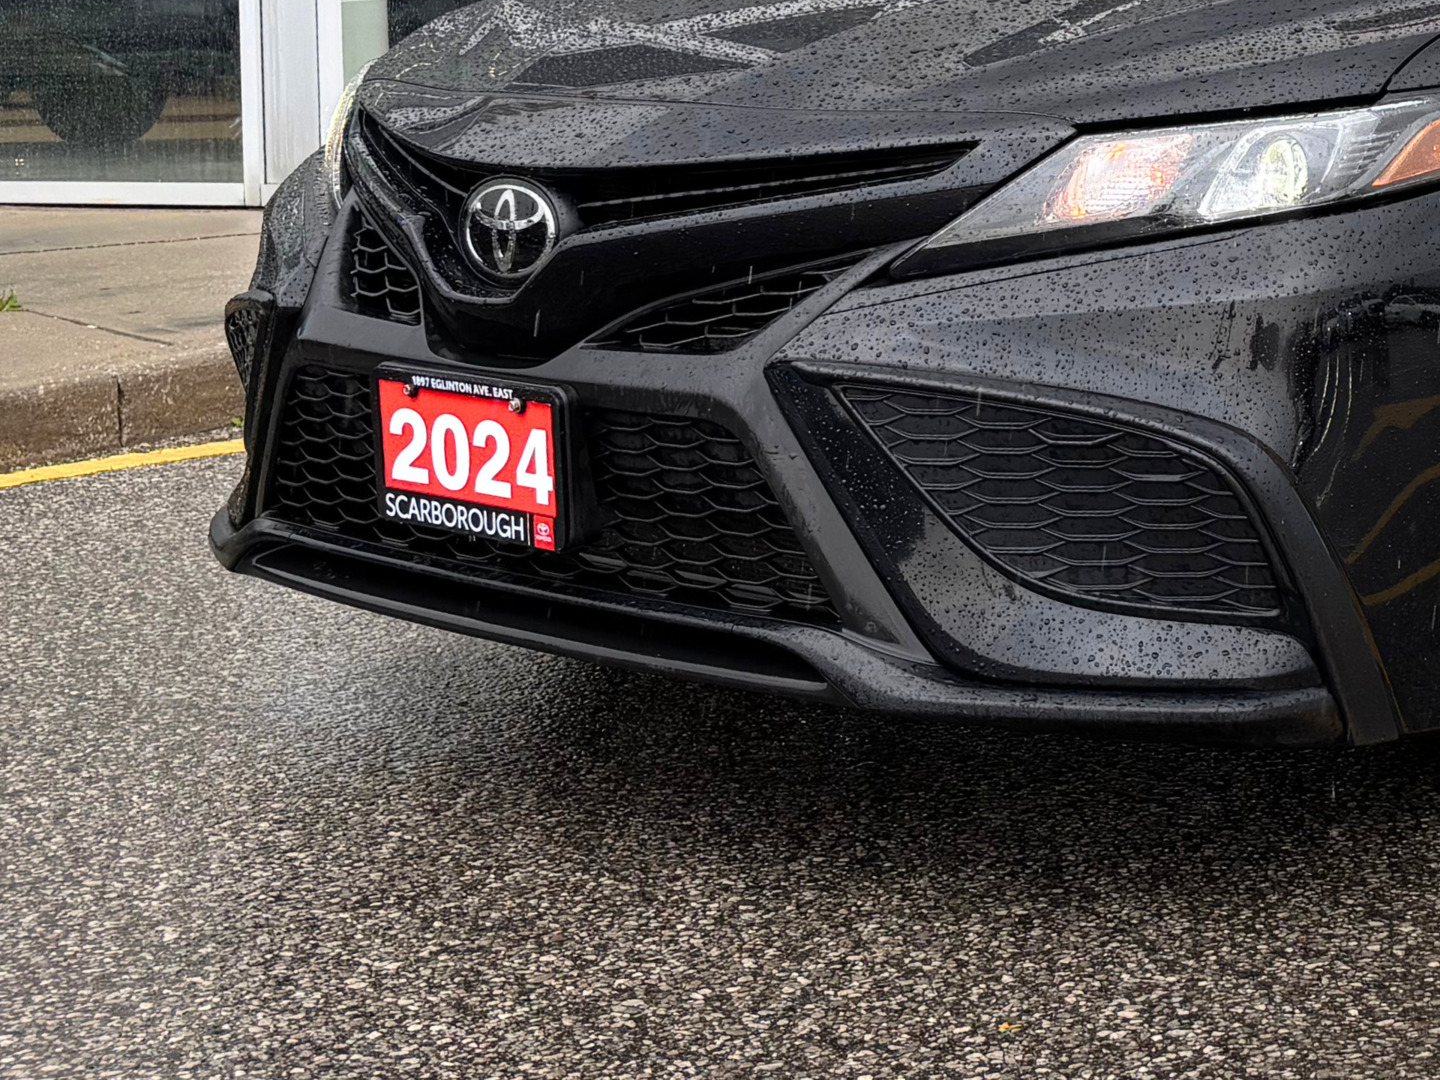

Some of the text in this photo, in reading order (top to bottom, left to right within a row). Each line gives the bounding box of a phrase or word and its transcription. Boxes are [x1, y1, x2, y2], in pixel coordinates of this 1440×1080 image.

[430, 378, 472, 394] EGLINTON
[473, 384, 492, 397] AVE.
[493, 388, 513, 400] EAST
[389, 407, 554, 506] 2024
[385, 493, 524, 542] SCARBOROUGH
